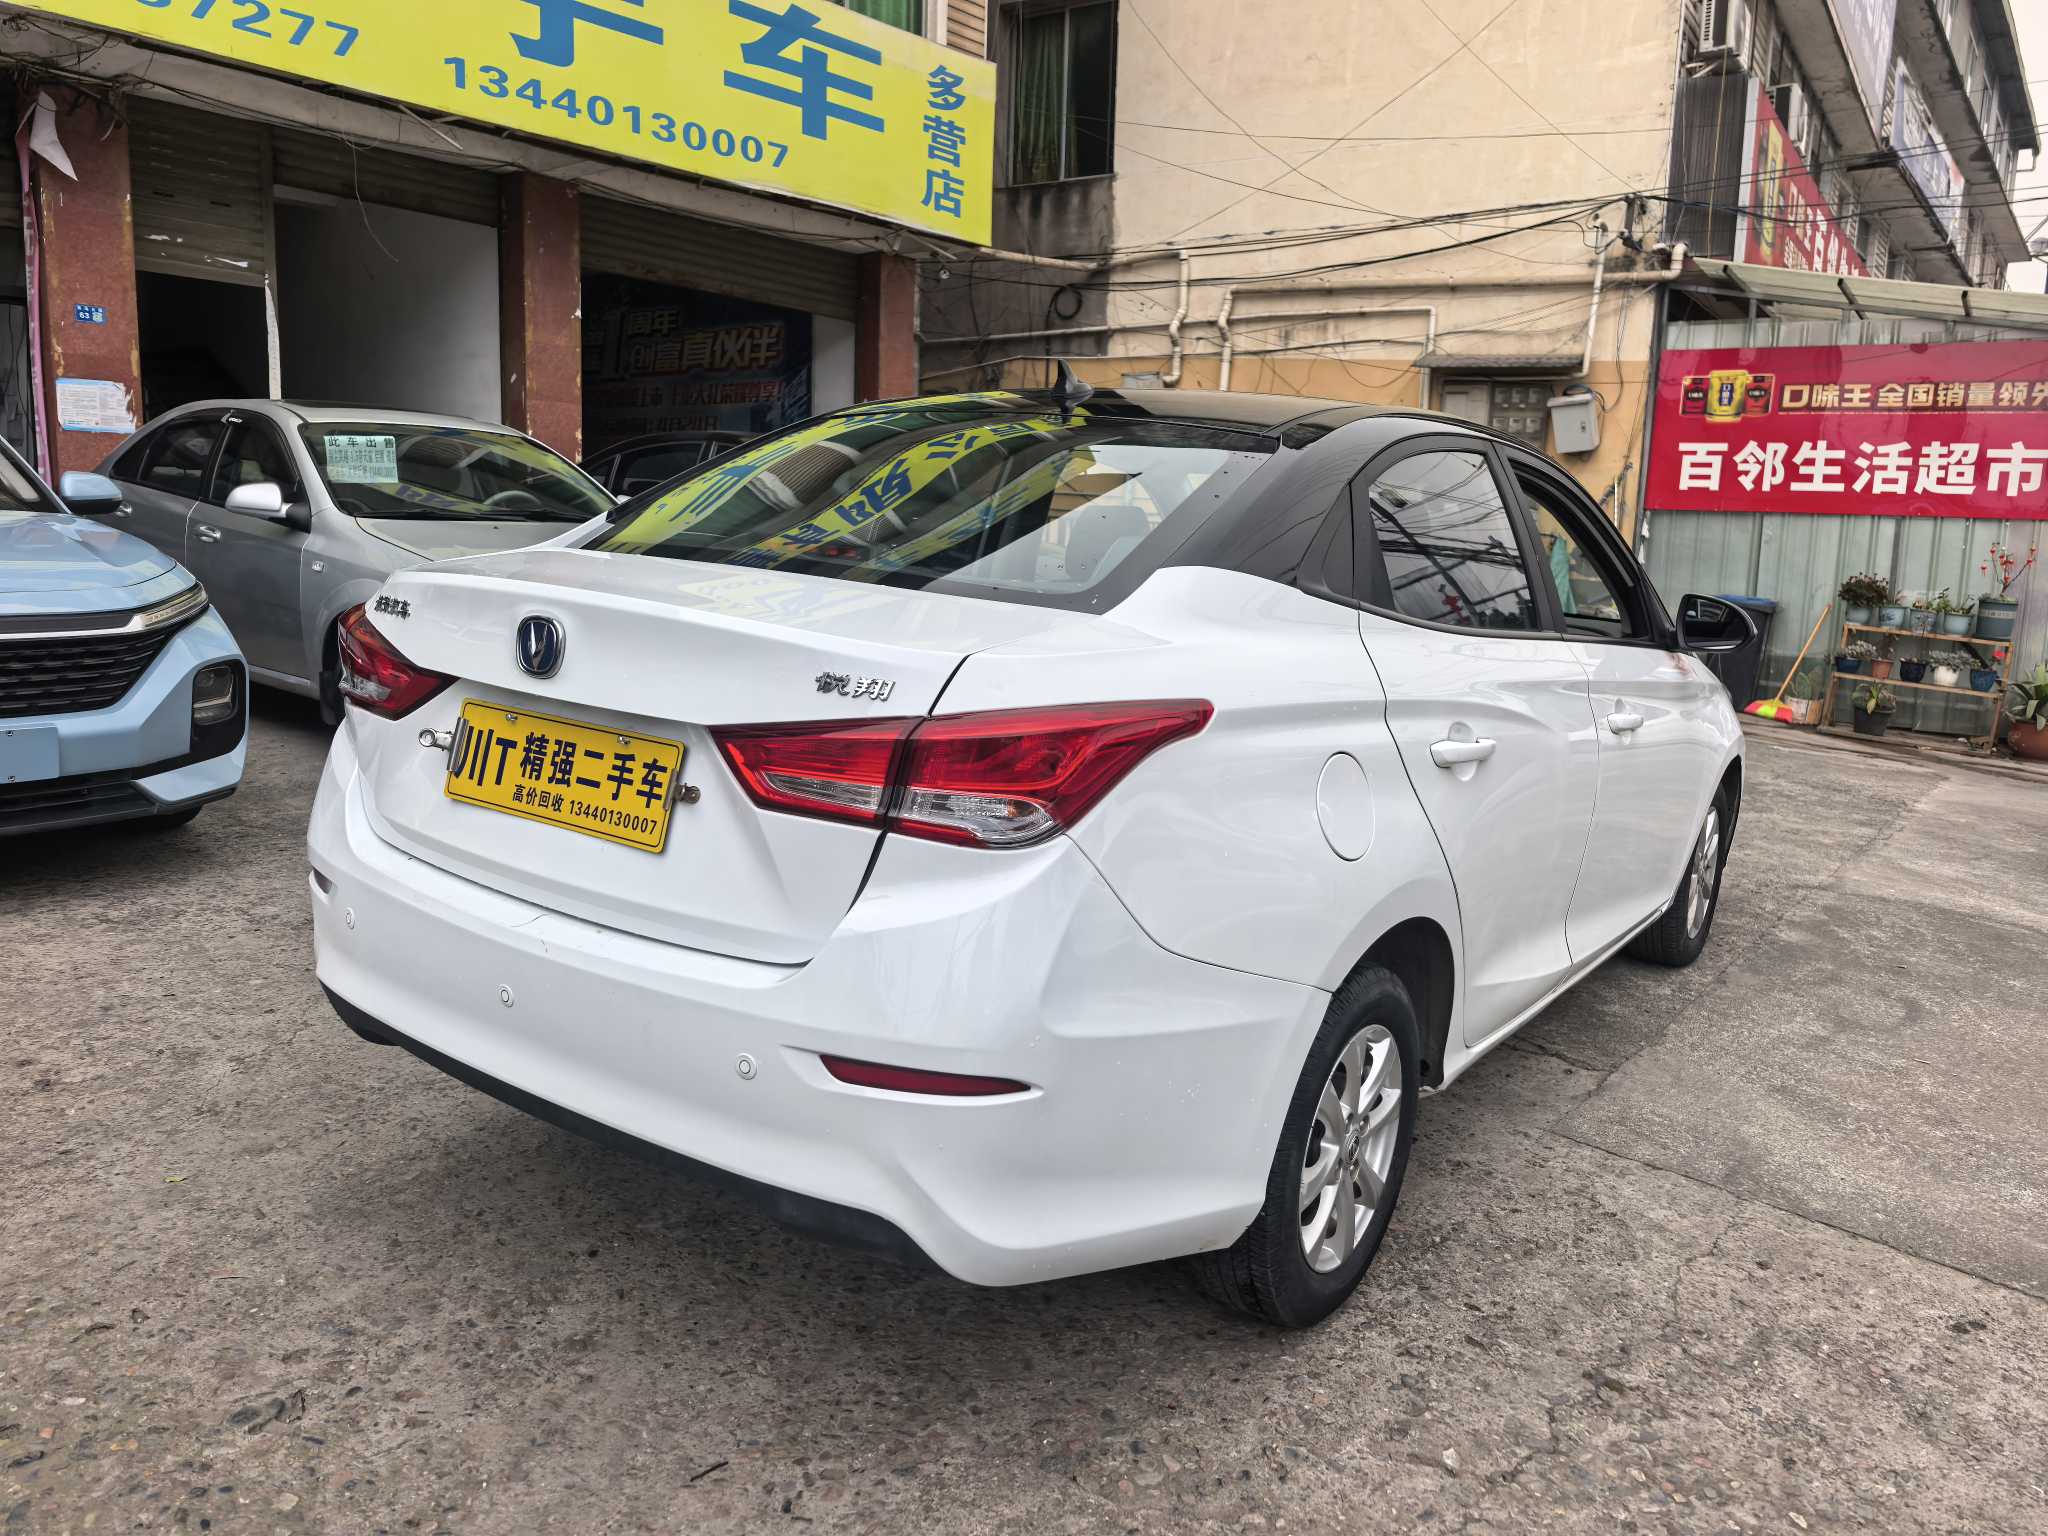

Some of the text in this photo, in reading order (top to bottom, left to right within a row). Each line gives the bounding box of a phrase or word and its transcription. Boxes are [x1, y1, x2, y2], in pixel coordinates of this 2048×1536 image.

[443, 56, 789, 169] 13440130007
[920, 65, 967, 219] 多营店
[1678, 440, 2048, 497] 百邻生活超市
[512, 783, 658, 835] 高价回收 13440130007
